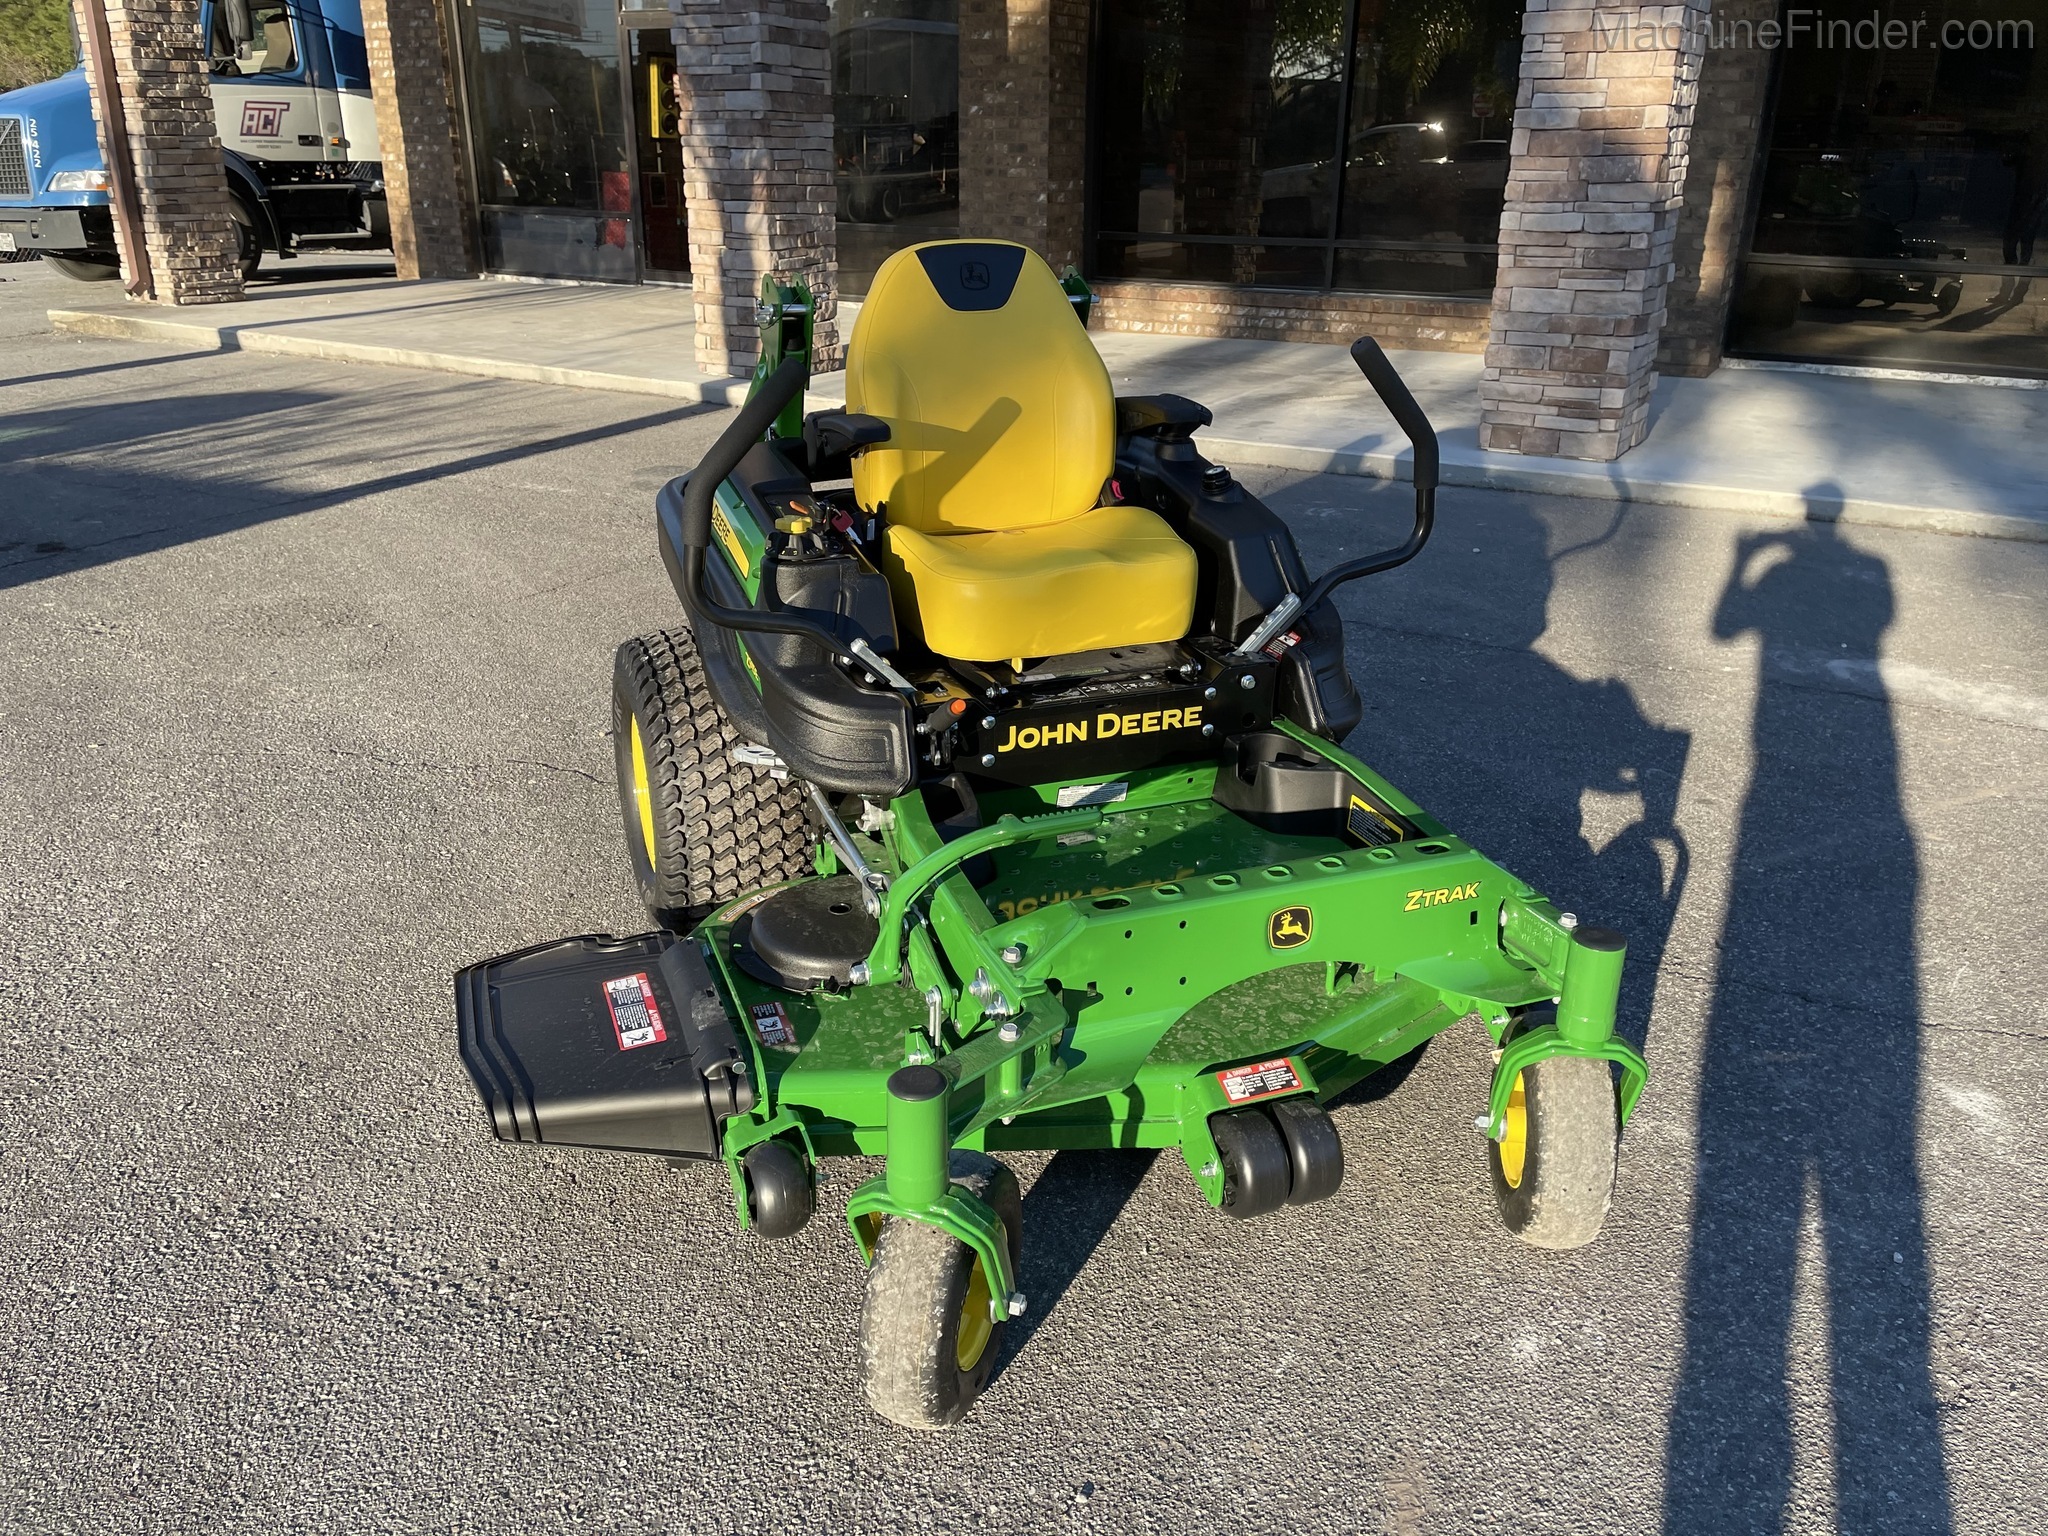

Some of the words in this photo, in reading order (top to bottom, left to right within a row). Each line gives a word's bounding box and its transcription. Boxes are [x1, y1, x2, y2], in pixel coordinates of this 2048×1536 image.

[240, 101, 290, 136] ACT
[712, 504, 731, 542] DEERE
[998, 721, 1087, 752] JOHN
[1097, 706, 1203, 739] DEERE
[1404, 881, 1482, 912] ZTRAK
